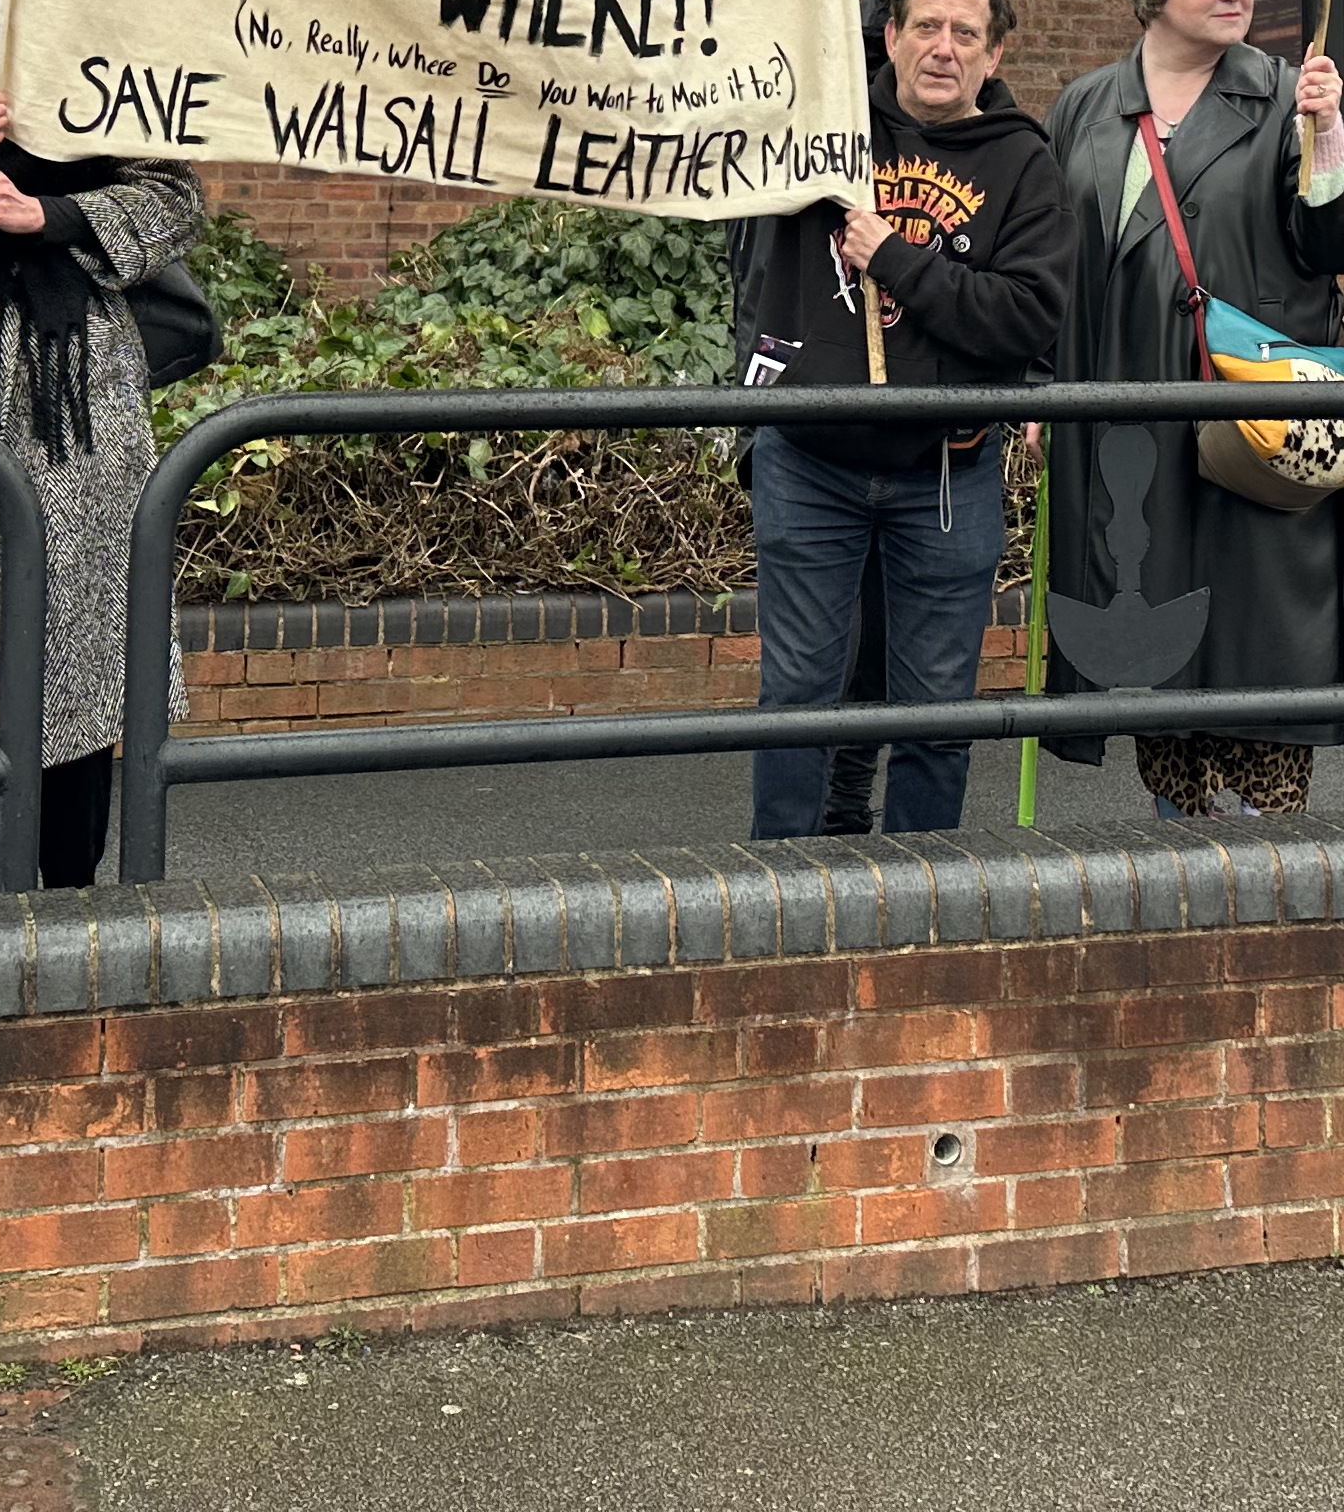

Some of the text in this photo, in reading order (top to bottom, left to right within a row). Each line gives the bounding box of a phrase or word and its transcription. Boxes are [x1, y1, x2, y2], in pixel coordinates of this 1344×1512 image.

[306, 19, 379, 75] Really,
[388, 43, 458, 77] Where
[477, 61, 513, 90] Do
[646, 83, 664, 113] to
[672, 79, 719, 111] Move
[728, 68, 745, 101] it
[59, 56, 872, 203] SAVE WALSALL LEATHER MUSEUM
[875, 180, 970, 234] ELLFIRE
